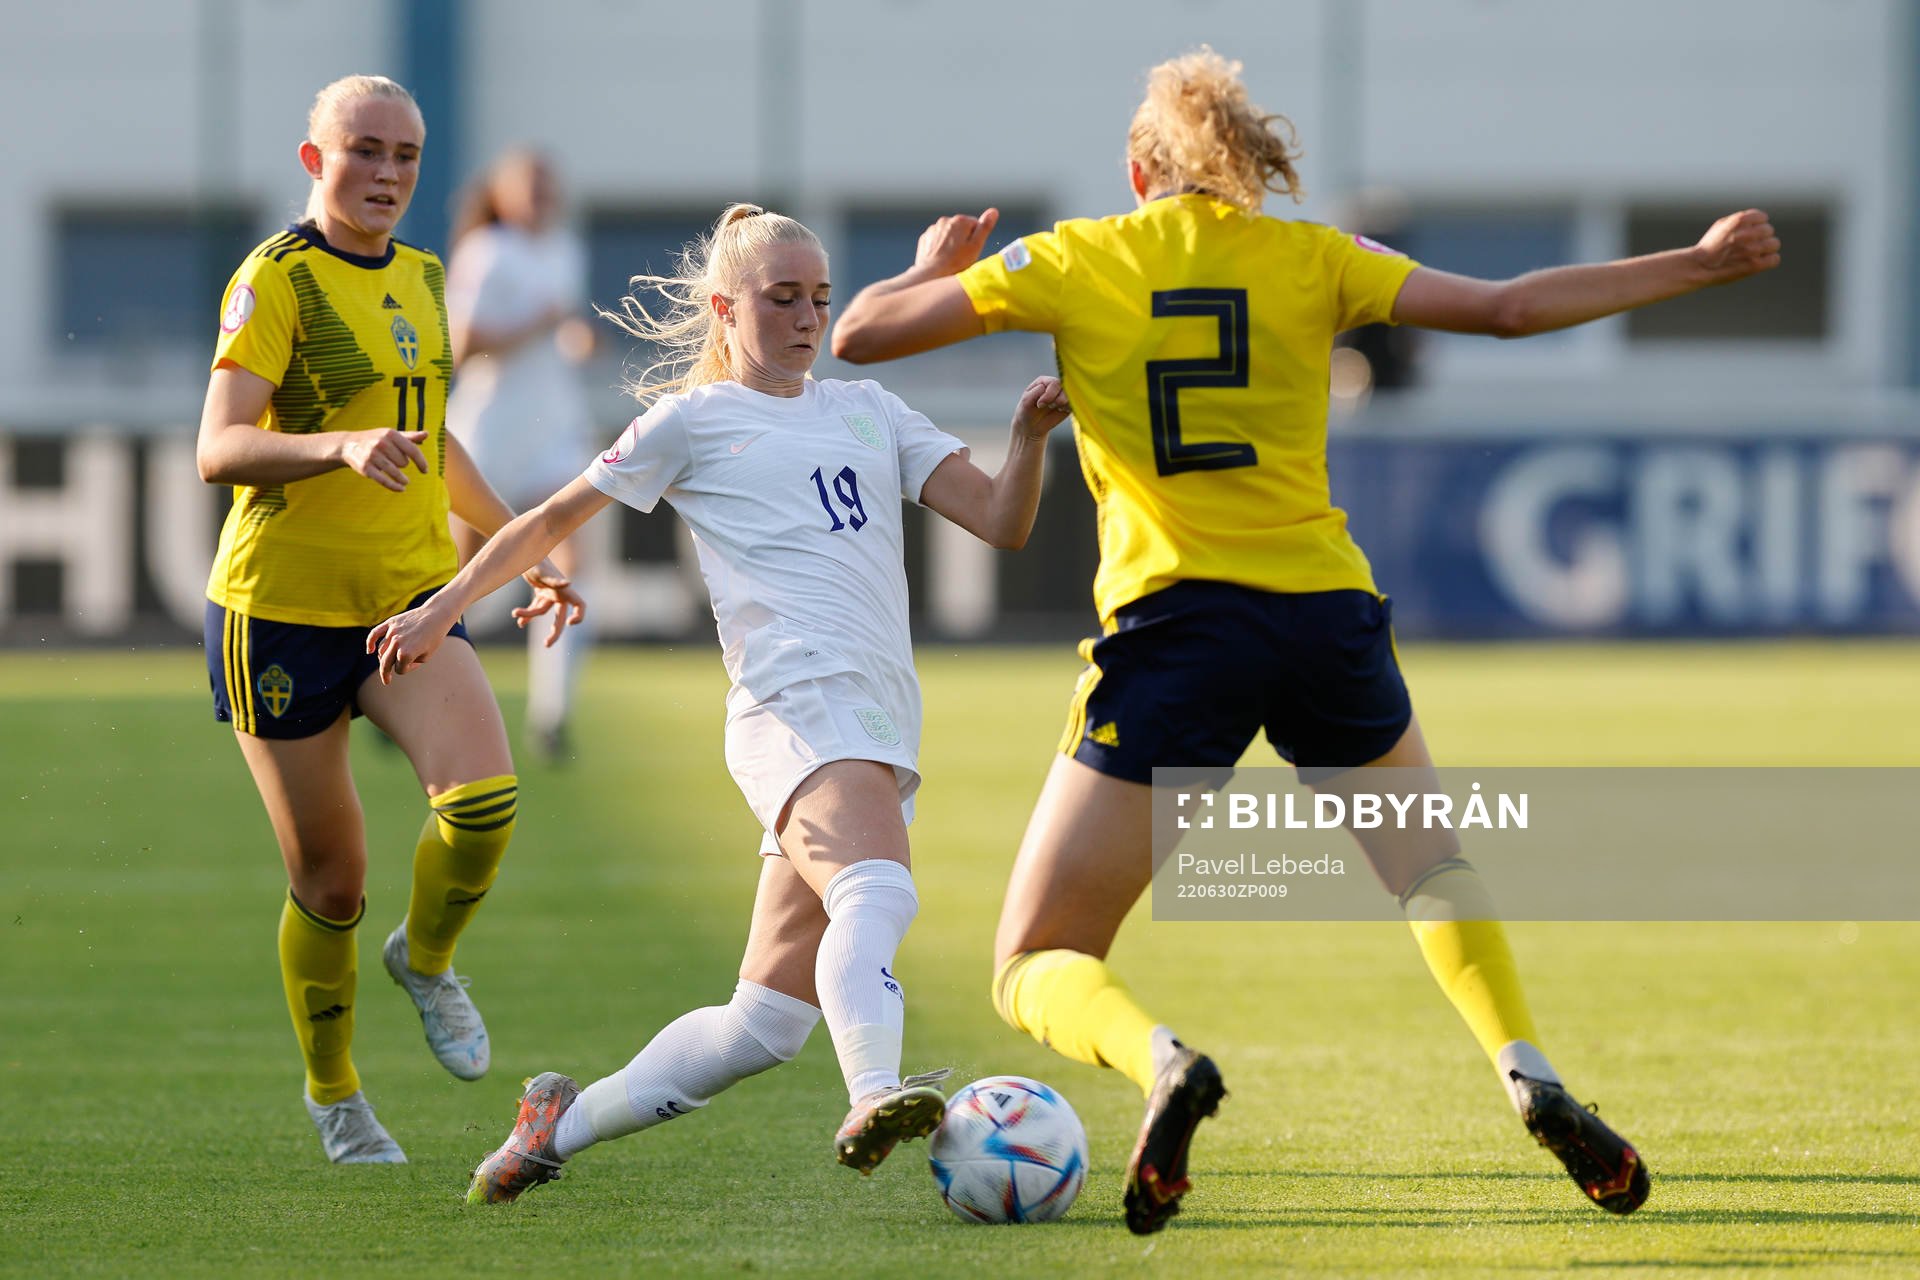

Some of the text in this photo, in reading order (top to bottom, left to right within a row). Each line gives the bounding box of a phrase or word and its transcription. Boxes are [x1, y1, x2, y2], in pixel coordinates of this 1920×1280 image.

[393, 376, 427, 432] 11
[1146, 287, 1258, 477] 2
[810, 465, 868, 532] 19
[1479, 444, 1920, 627] GRIF
